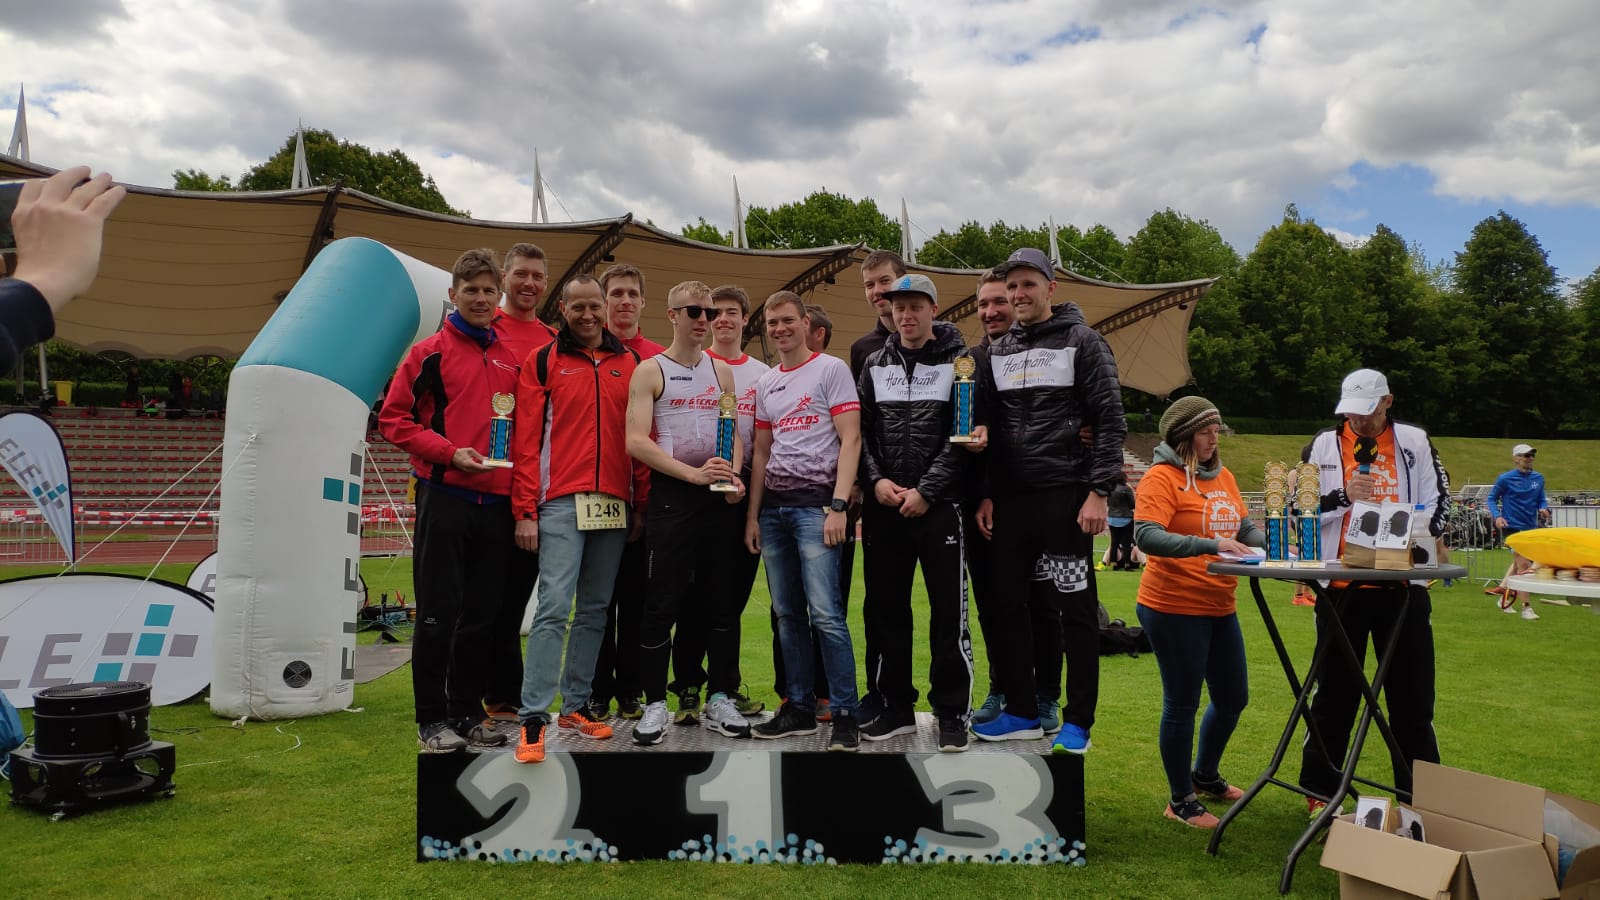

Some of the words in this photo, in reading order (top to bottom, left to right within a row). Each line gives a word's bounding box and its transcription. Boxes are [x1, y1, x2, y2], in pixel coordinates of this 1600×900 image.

[0, 438, 42, 485] ELE
[586, 503, 621, 518] 1248
[1209, 521, 1241, 531] TRIATHLO
[456, 752, 596, 862] 2
[686, 752, 785, 862] 1
[907, 753, 1060, 863] 3
